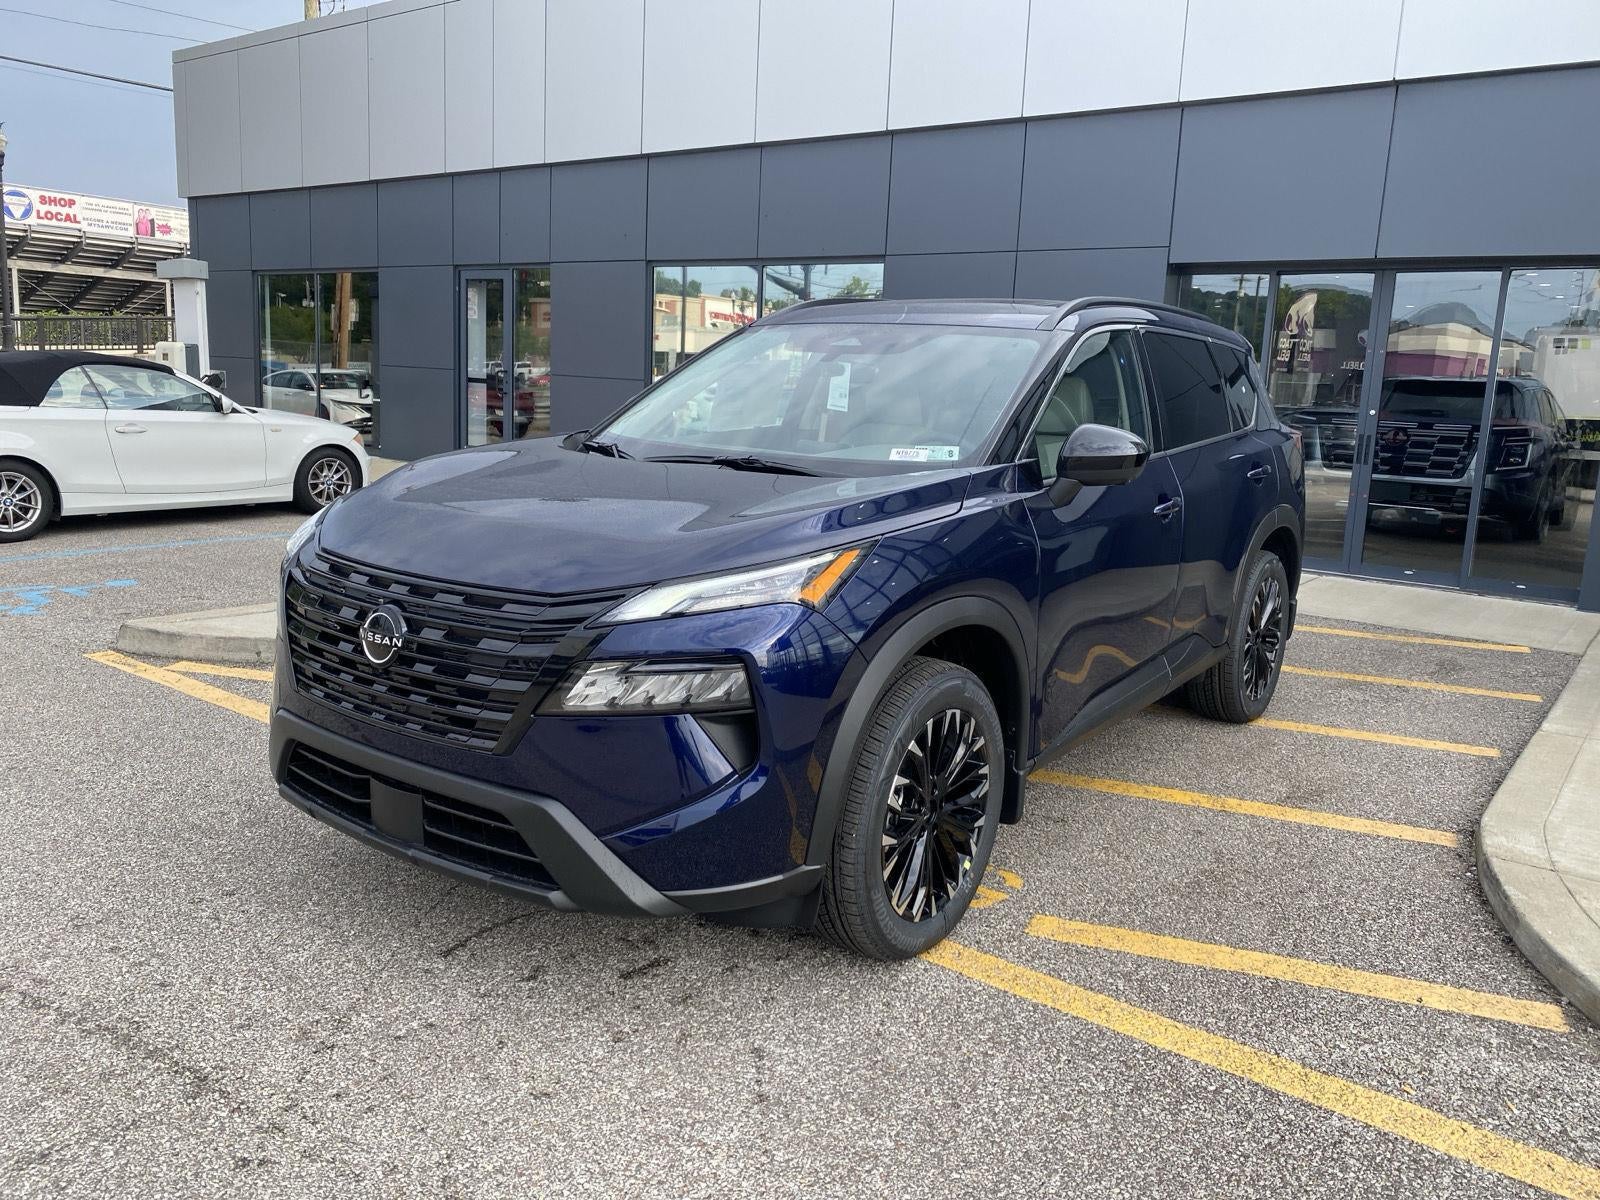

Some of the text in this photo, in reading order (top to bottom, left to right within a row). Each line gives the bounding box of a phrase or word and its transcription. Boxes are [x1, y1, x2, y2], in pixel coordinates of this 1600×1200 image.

[38, 195, 76, 208] SHOP
[36, 209, 81, 224] LOCAL
[360, 628, 402, 647] NISSAN
